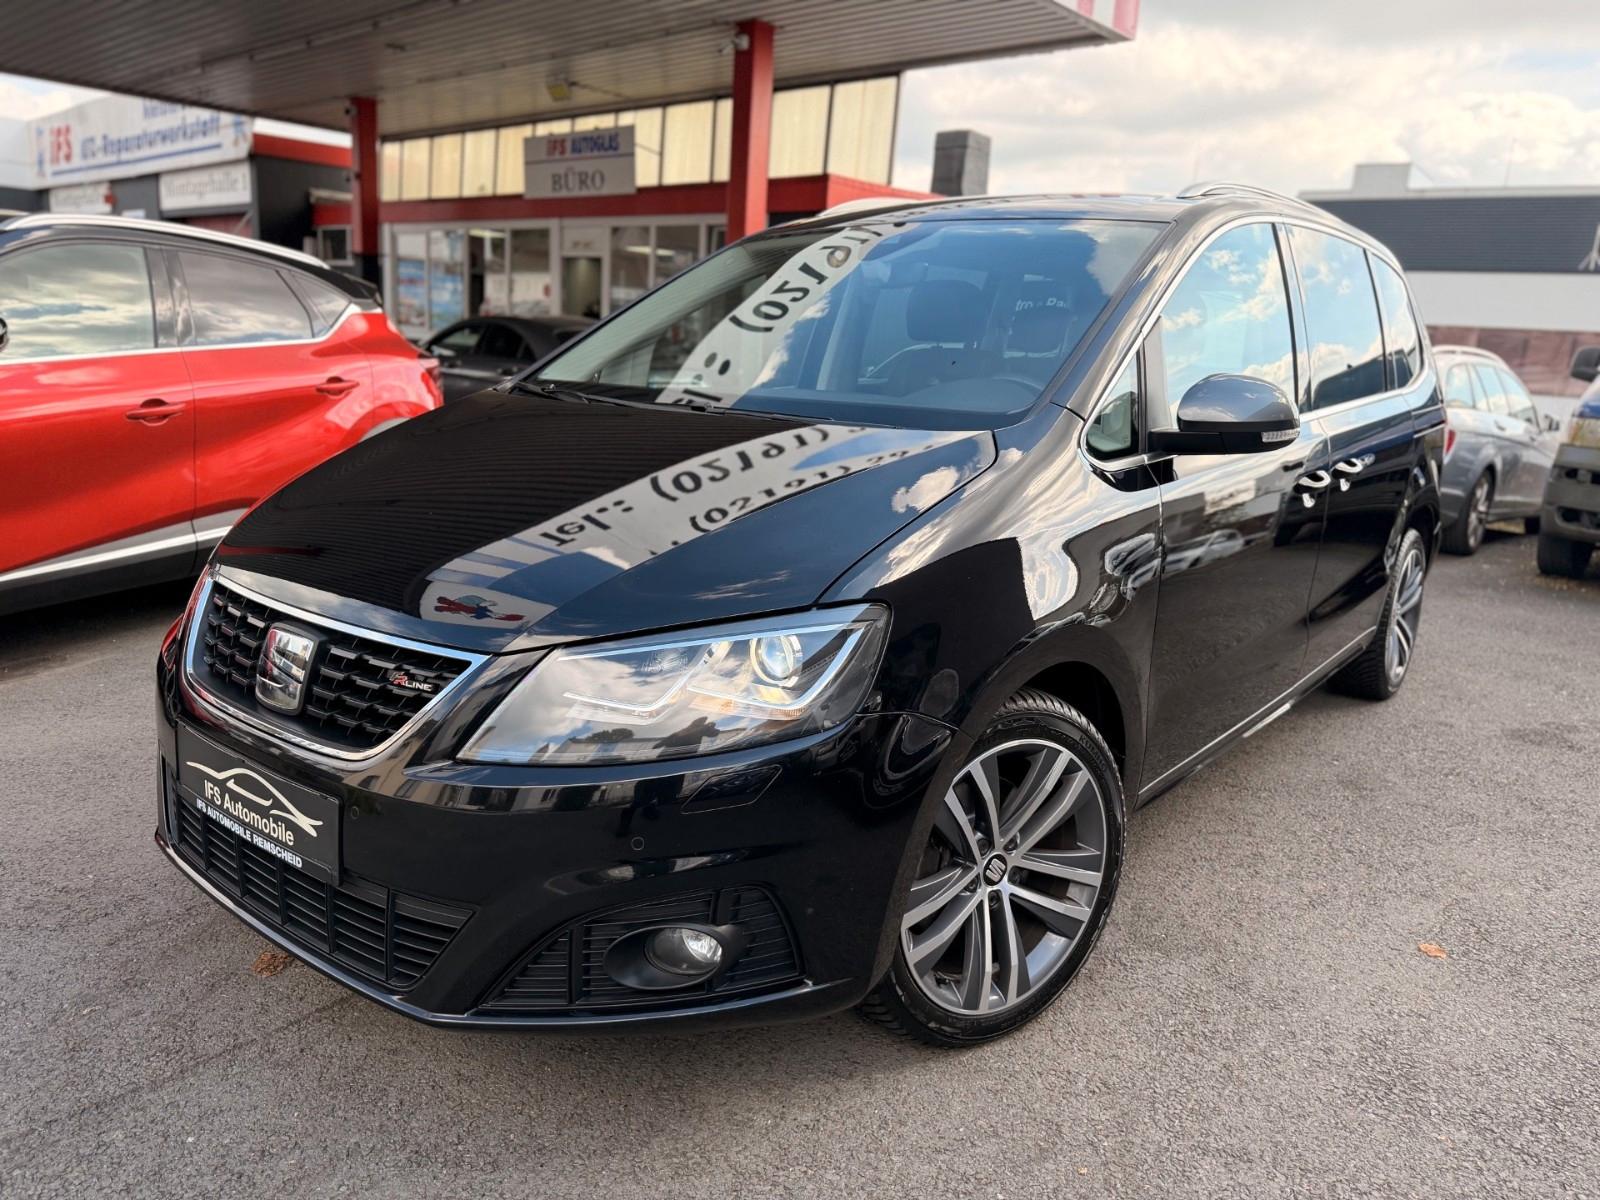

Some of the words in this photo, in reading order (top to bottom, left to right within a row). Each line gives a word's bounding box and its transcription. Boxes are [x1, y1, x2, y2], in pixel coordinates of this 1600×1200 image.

[551, 166, 605, 192] BÜRO
[196, 798, 207, 814] IFS
[207, 805, 251, 843] AUTOMOBILE
[252, 833, 303, 869] REMSCHEID
[204, 779, 222, 805] IFS
[223, 792, 295, 846] Automobile
